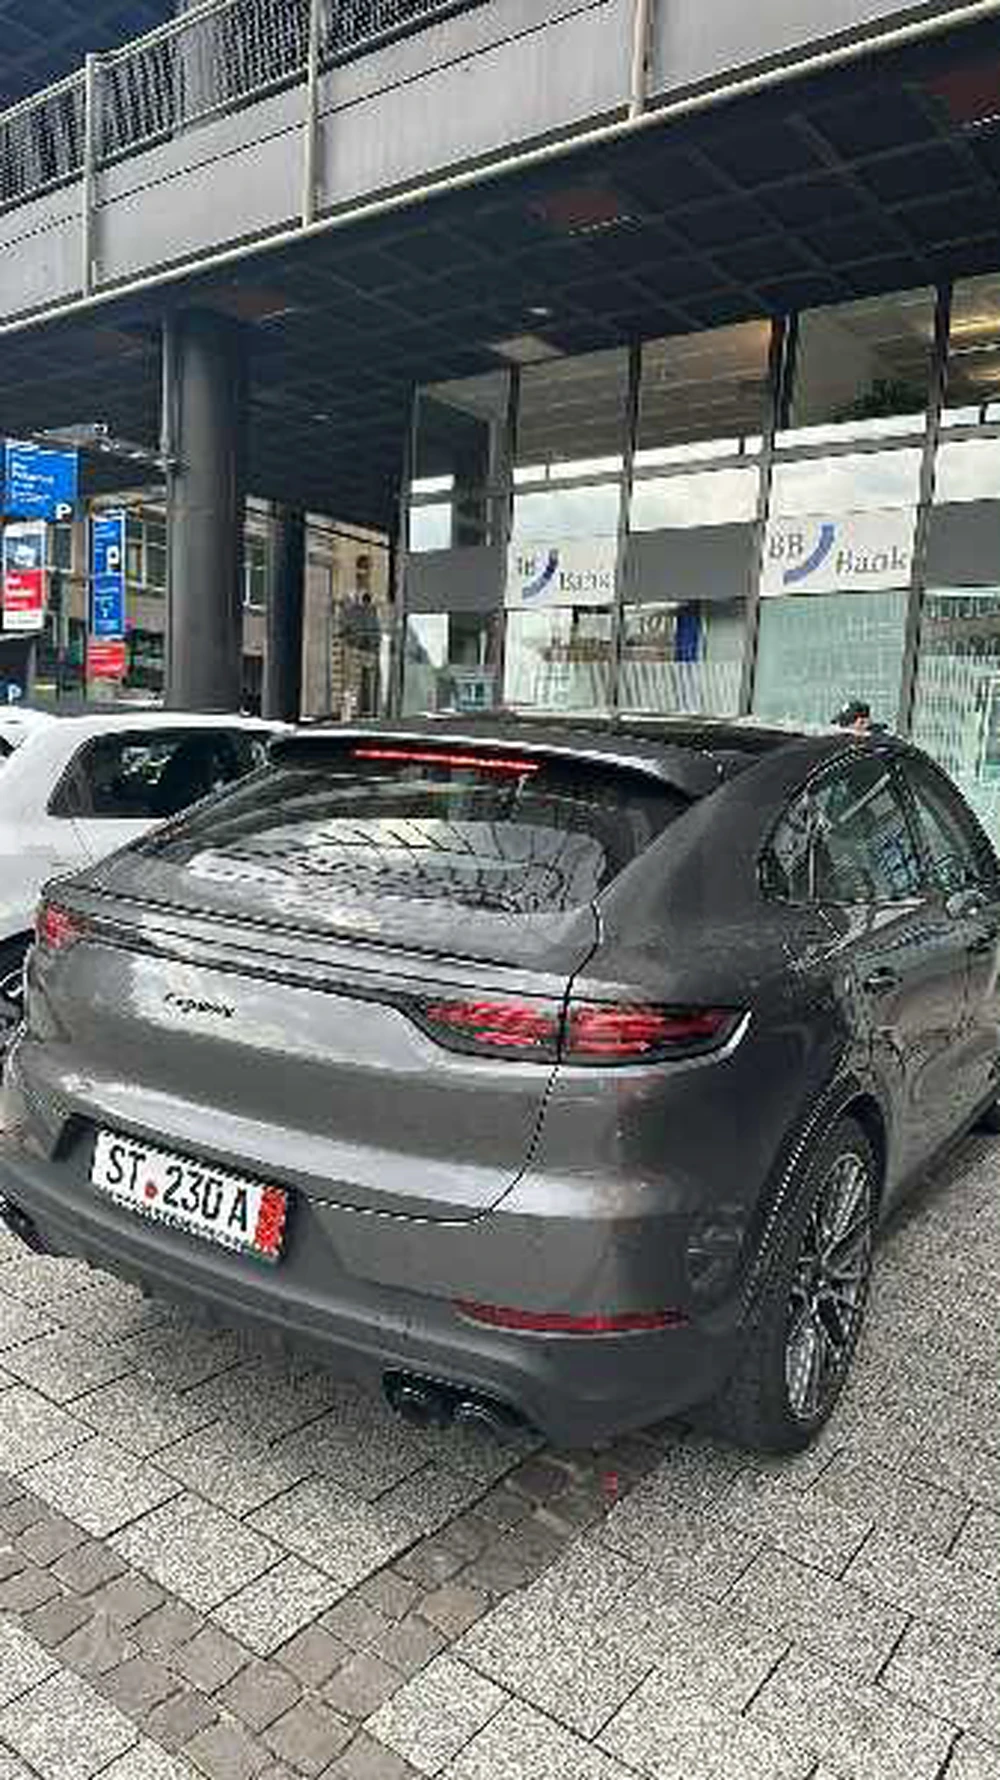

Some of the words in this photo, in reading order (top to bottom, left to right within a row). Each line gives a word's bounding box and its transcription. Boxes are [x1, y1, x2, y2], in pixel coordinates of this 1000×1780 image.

[770, 533, 804, 559] BB
[836, 546, 907, 574] Bank
[106, 1144, 147, 1191] ST
[162, 1165, 224, 1220] 230
[227, 1187, 248, 1232] A
